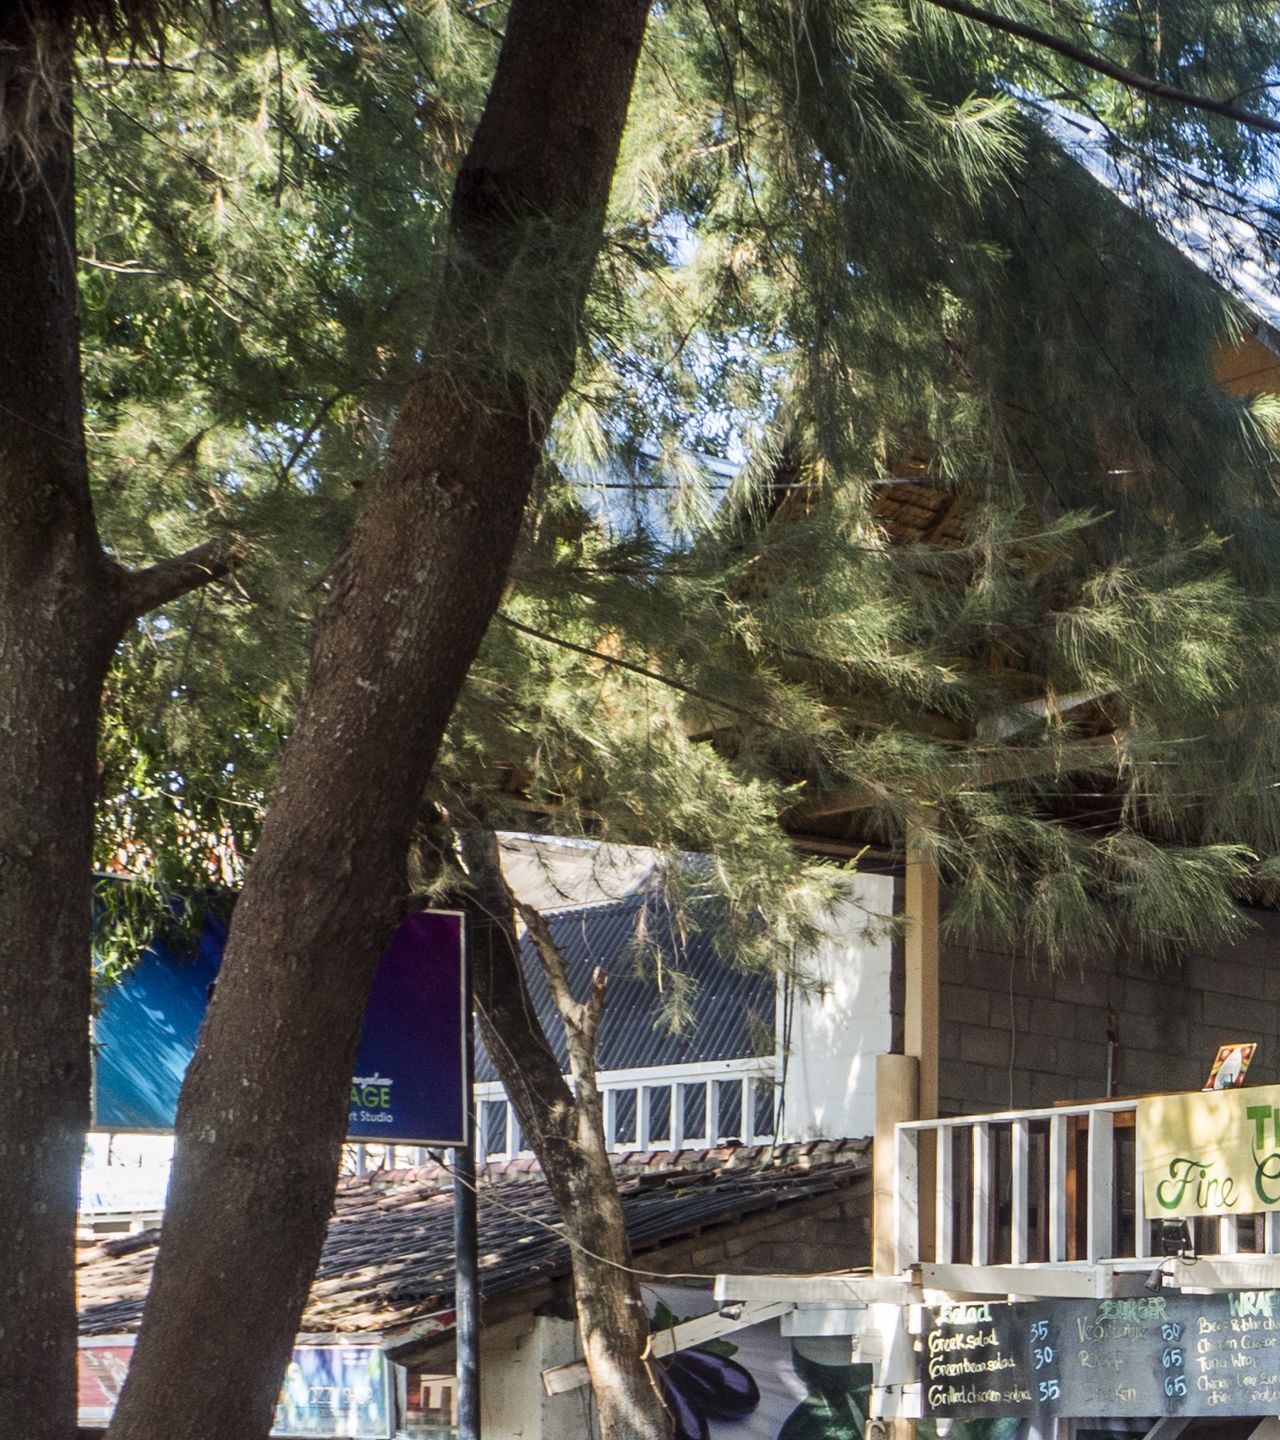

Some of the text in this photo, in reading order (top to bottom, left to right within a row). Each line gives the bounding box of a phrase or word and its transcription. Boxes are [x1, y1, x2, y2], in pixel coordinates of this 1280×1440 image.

[360, 1110, 393, 1123] Studio
[1156, 1157, 1241, 1210] Fine
[1029, 1320, 1049, 1343] 35
[1161, 1322, 1181, 1341] 50
[1034, 1346, 1053, 1370] 30
[1163, 1348, 1182, 1369] 65
[1039, 1380, 1060, 1402] 35
[1164, 1376, 1188, 1397] 65
